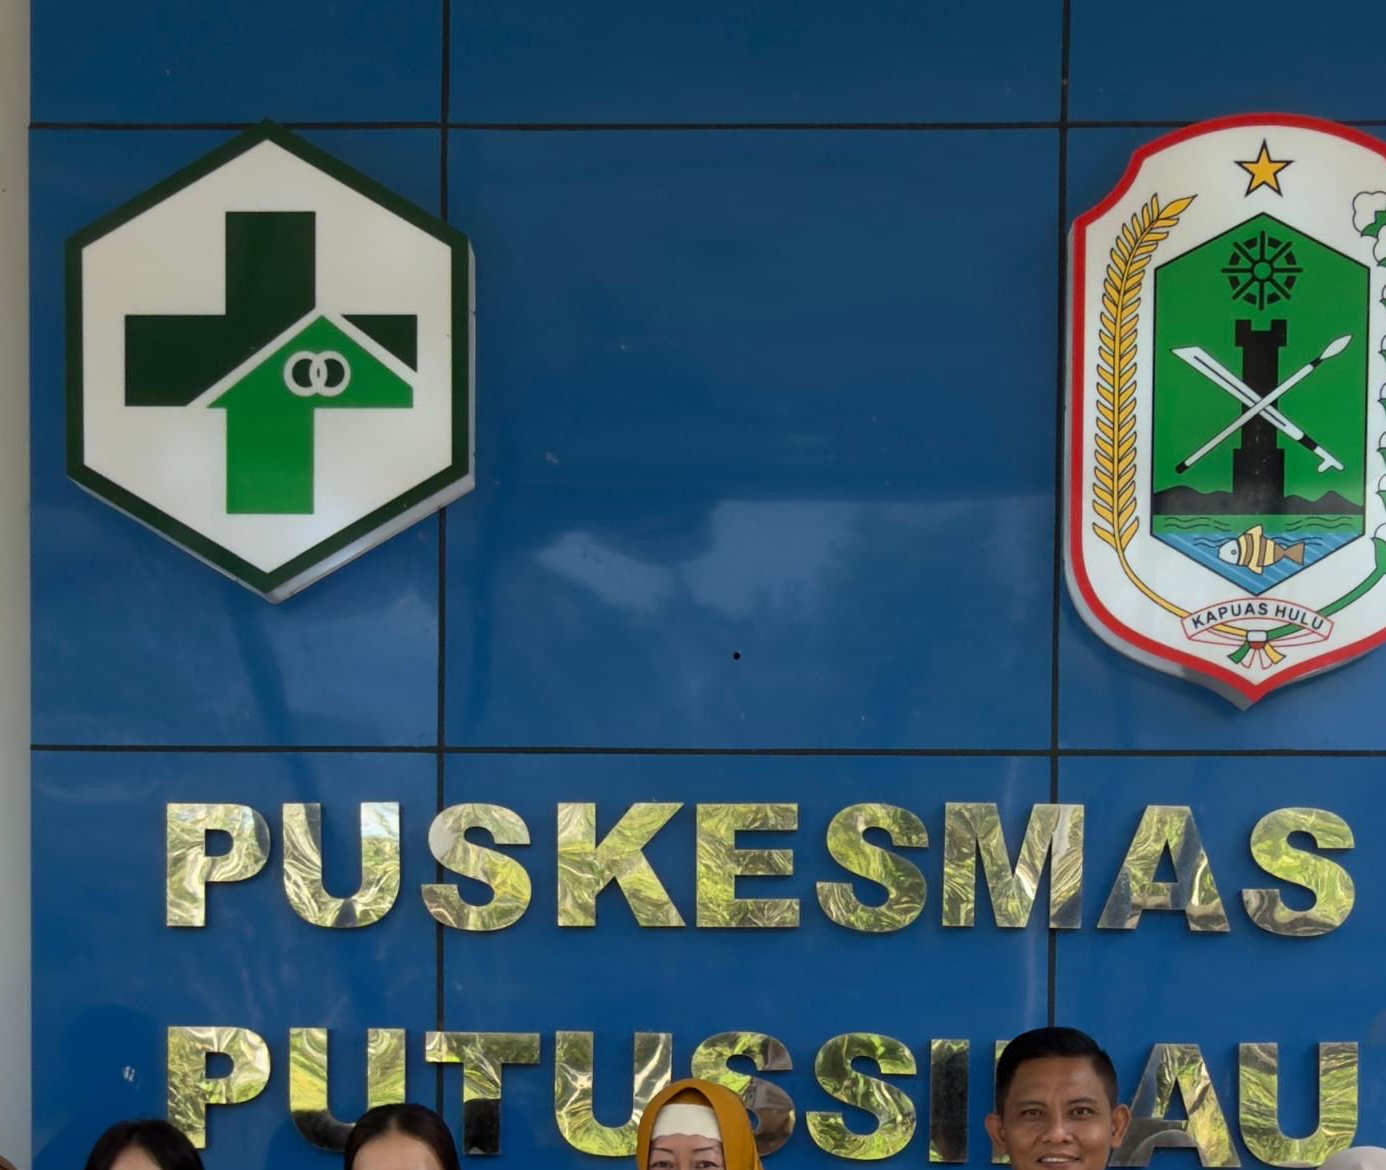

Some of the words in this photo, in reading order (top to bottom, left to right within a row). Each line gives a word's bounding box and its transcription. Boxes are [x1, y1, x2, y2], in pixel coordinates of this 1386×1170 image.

[1192, 603, 1268, 629] KAPUAS
[1275, 604, 1324, 630] HULU
[166, 802, 1356, 937] PUSKESMAS
[166, 1026, 1359, 1168] PUTUSSIAU
